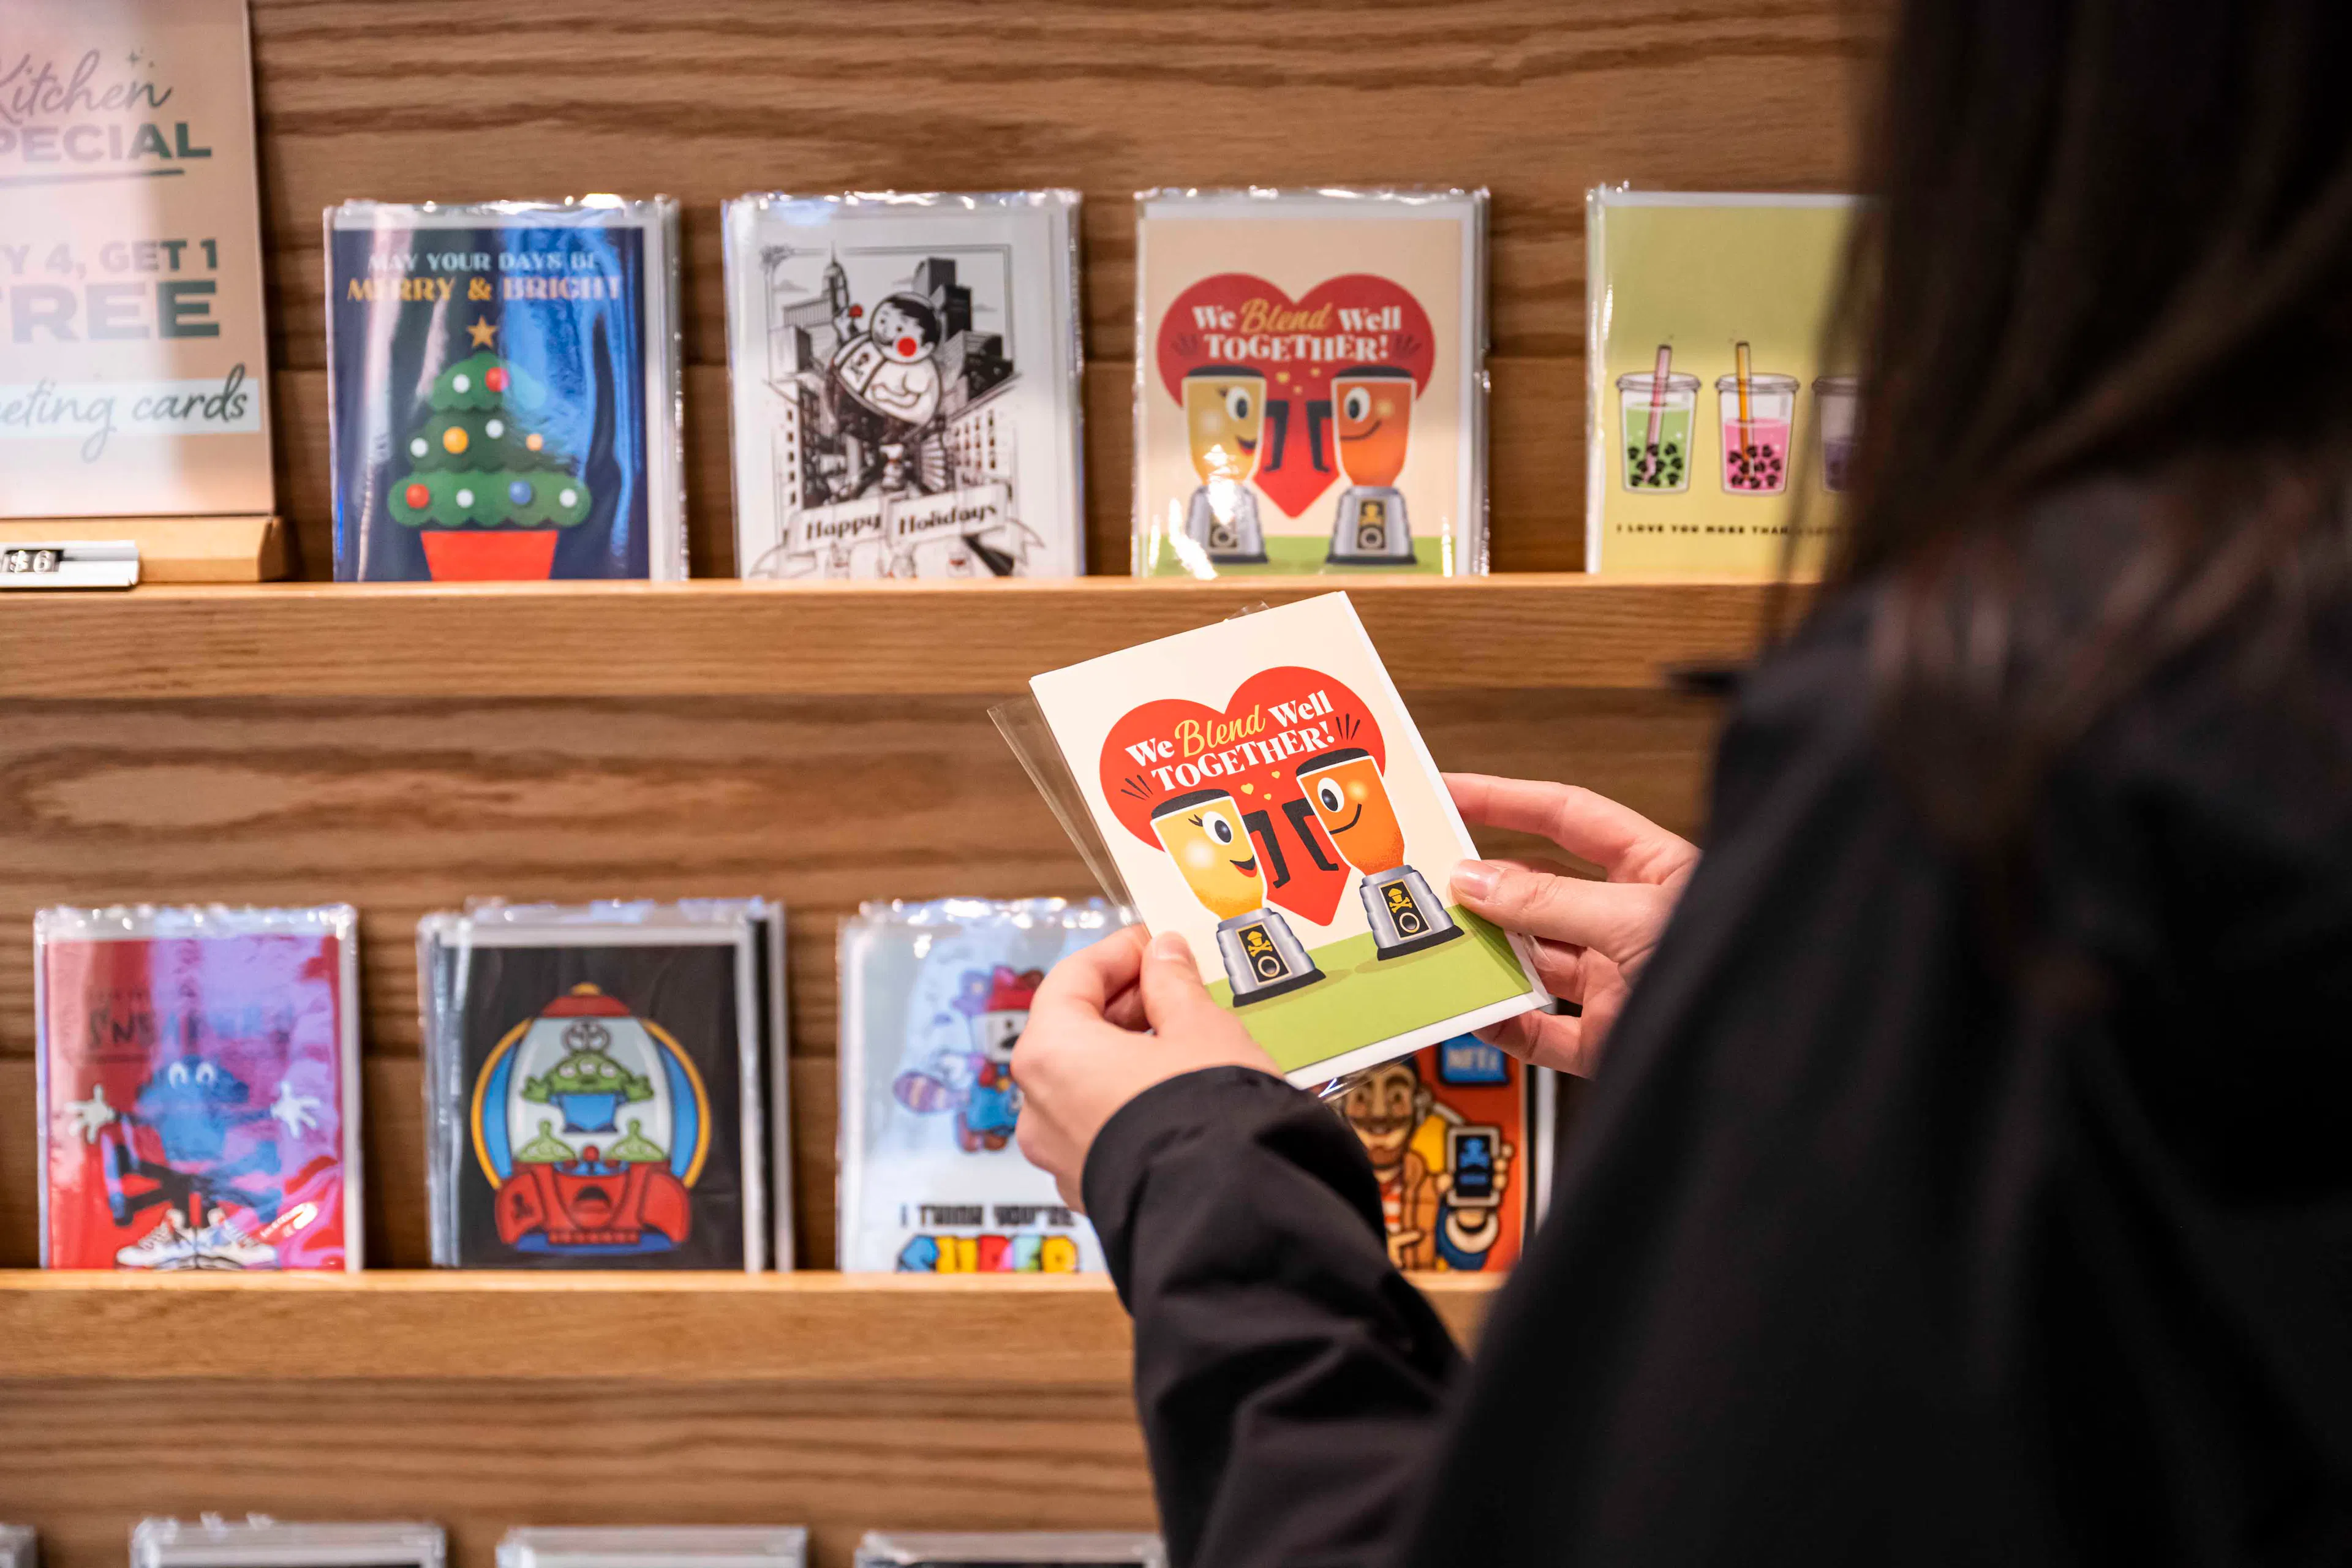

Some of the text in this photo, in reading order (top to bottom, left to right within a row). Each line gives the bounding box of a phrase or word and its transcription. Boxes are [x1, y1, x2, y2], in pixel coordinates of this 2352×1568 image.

[99, 238, 187, 273] GET
[199, 238, 218, 270] 1
[369, 252, 418, 271] MAY
[427, 252, 490, 271] YOUR
[499, 252, 562, 271] DAYS
[347, 276, 620, 301] MERRY & BRIGHT
[0, 279, 220, 343] REE
[1193, 298, 1403, 335] We Blend Well
[1204, 333, 1389, 362] TOGETHER!
[131, 362, 248, 423] cards
[806, 504, 998, 540] Happy Holidays
[1627, 524, 1665, 534] LOVE
[1671, 524, 1699, 534] YOU
[1705, 525, 1746, 535] MORE
[1125, 690, 1334, 767] We Blend Well
[1151, 721, 1335, 791] TOGETHER!
